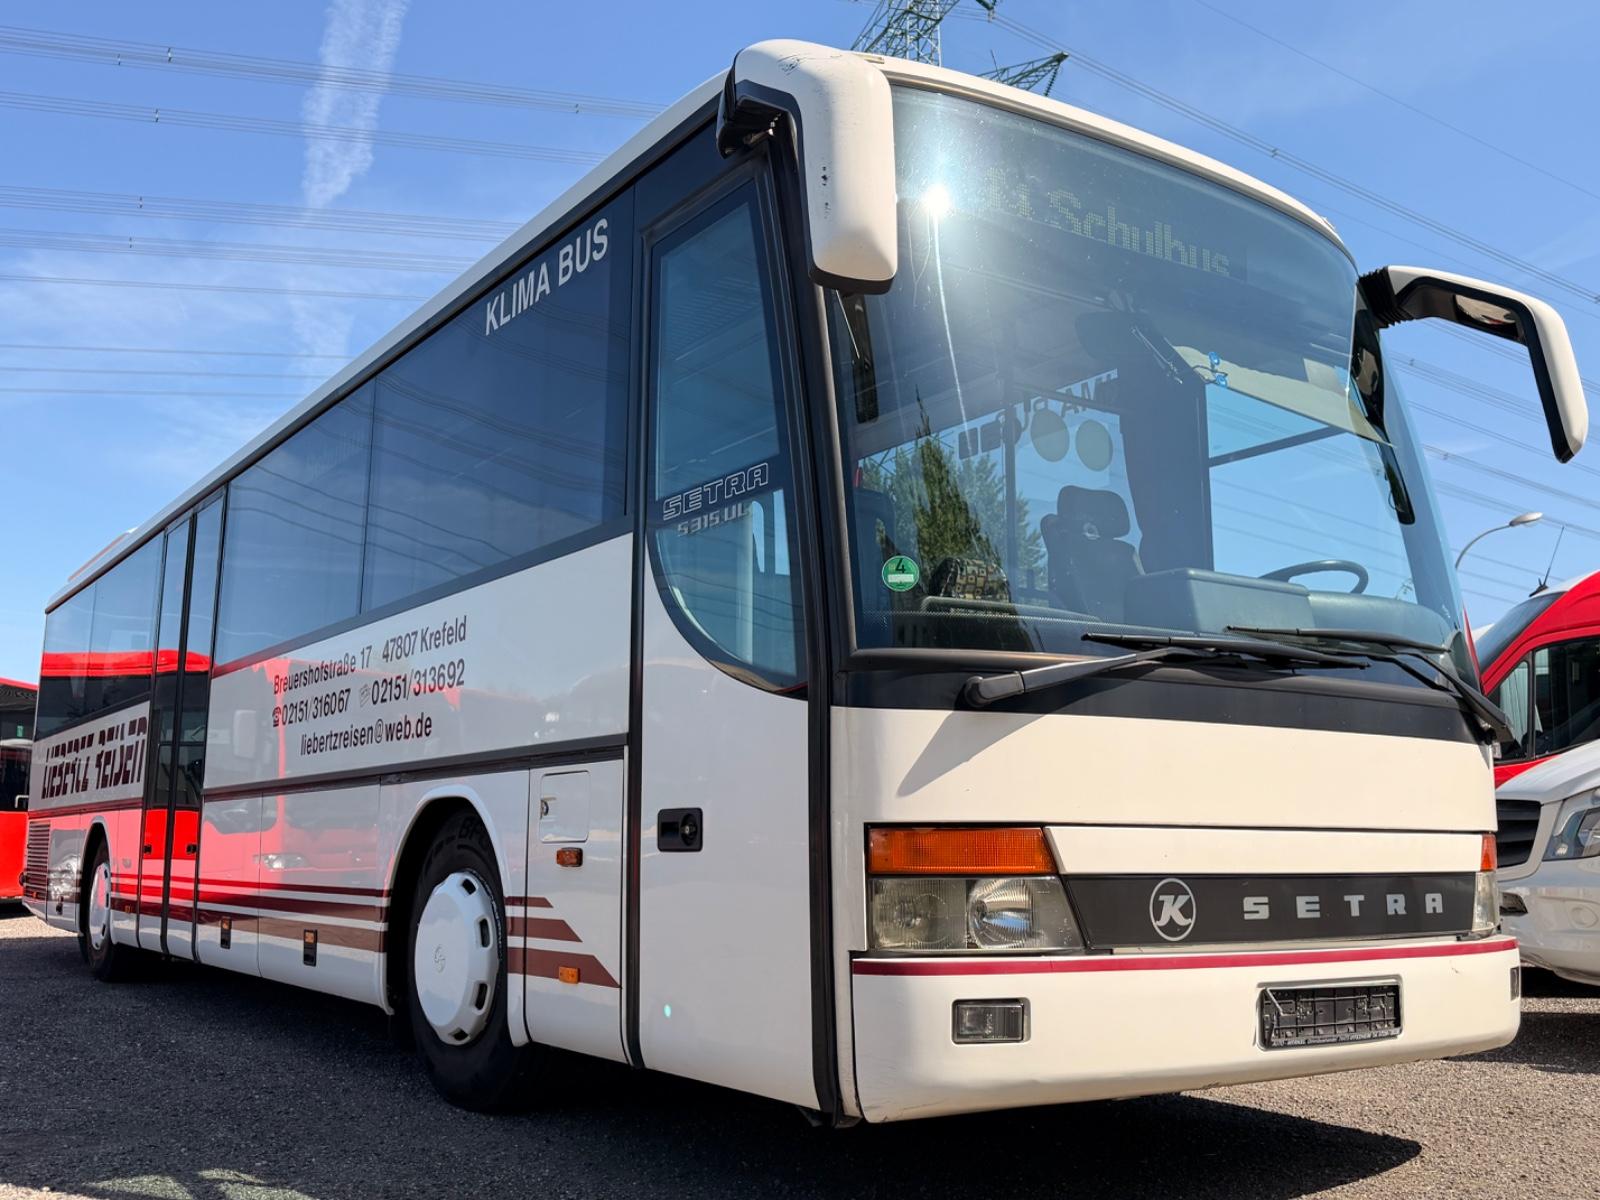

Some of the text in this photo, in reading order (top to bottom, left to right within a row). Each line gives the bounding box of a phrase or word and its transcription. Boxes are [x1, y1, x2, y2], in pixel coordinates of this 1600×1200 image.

[485, 218, 608, 336] KLIMA BUS
[663, 463, 768, 520] SETRA
[895, 558, 906, 573] 4
[273, 615, 467, 694] Breuershofstraße 17 47807 Krefeld
[281, 658, 465, 726] 02151/316067 02151/313692
[300, 712, 432, 756] liebertzreisen@web.de
[1243, 893, 1444, 920] SETRA
